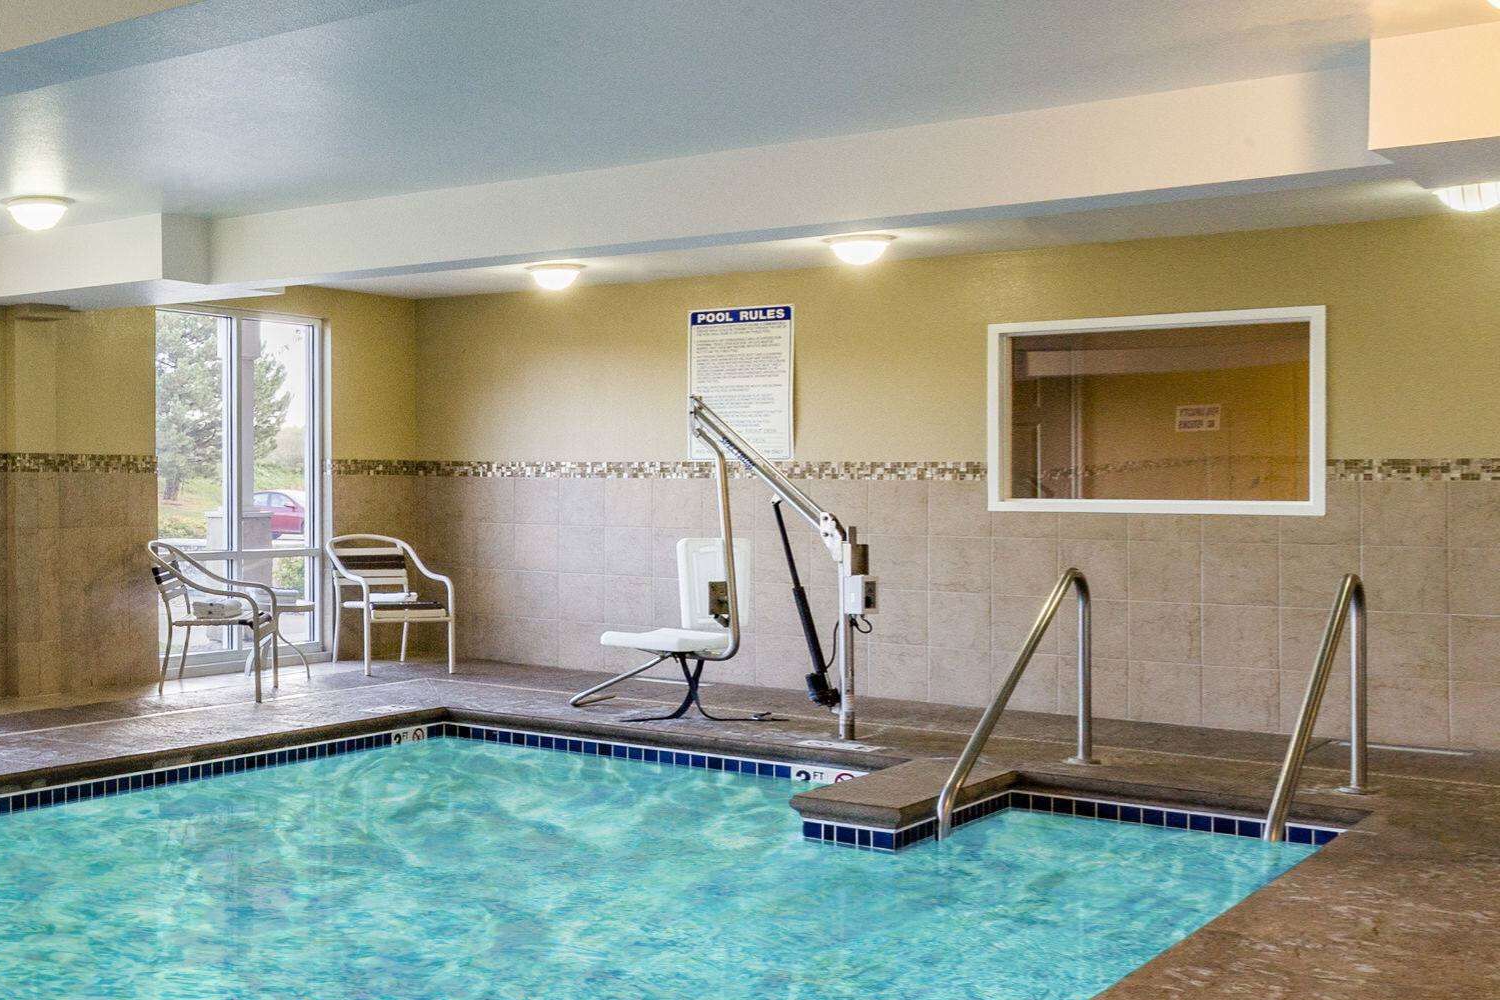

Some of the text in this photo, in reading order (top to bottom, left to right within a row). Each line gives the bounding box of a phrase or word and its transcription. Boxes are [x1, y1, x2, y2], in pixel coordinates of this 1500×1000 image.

[697, 308, 786, 324] POOL RULES
[813, 771, 824, 780] FT
